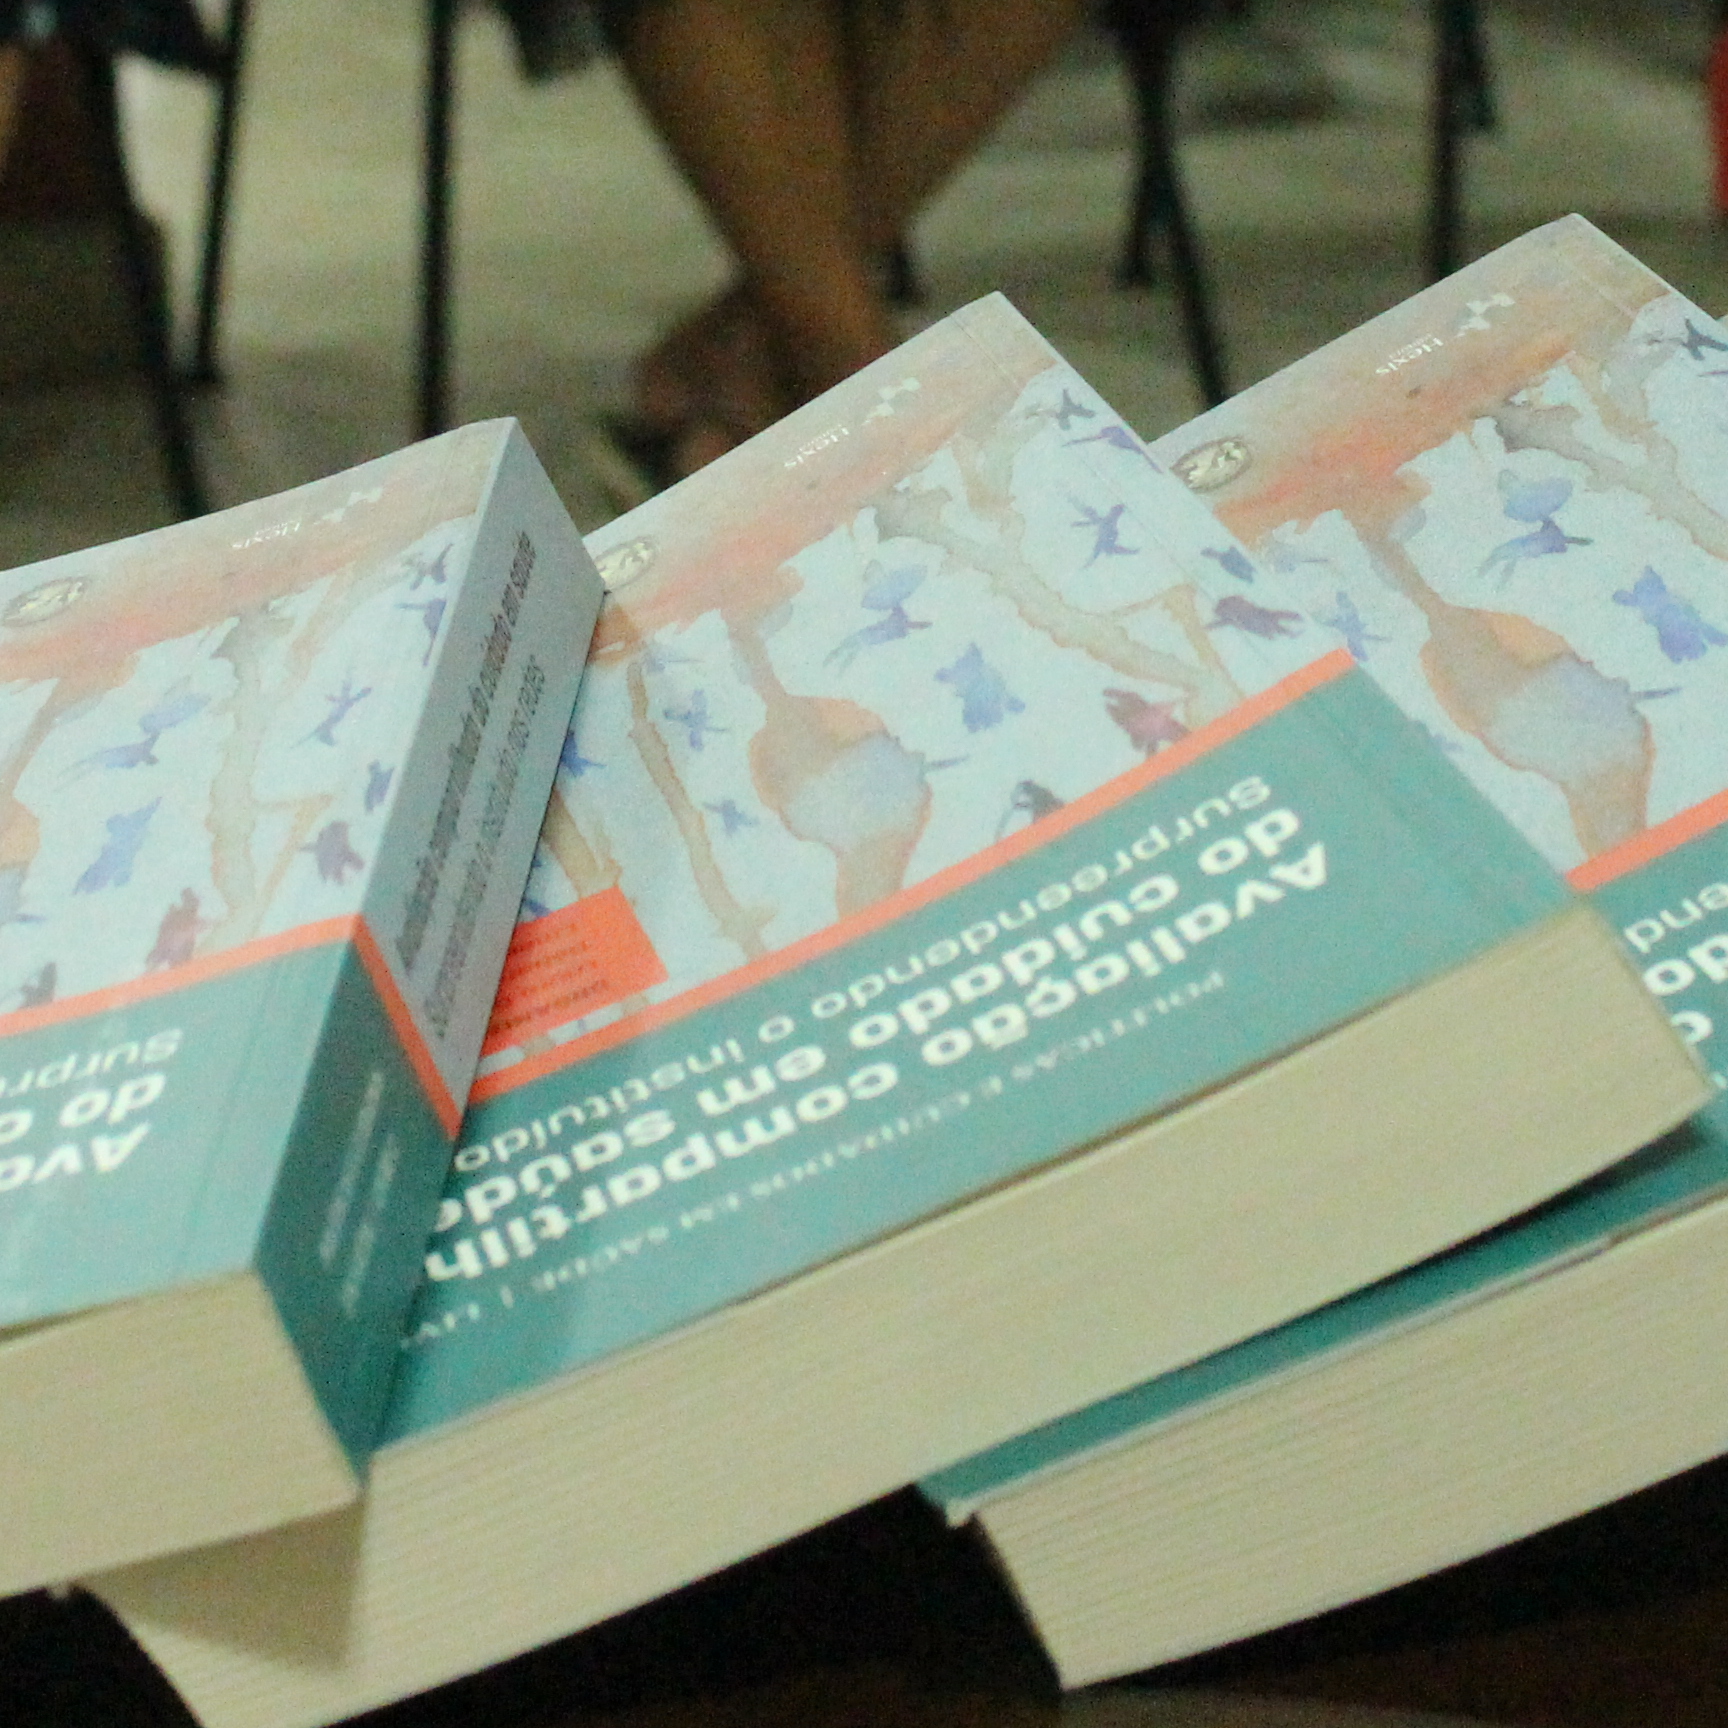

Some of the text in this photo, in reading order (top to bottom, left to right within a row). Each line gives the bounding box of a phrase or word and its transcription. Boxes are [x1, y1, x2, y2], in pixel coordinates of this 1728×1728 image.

[1197, 807, 1301, 876] do
[848, 873, 1181, 1050] cuidado
[921, 841, 1328, 1067] Avaliação
[757, 1014, 796, 1044] o
[58, 1072, 166, 1129] do
[453, 1038, 745, 1173] instituído
[696, 1044, 827, 1117] em
